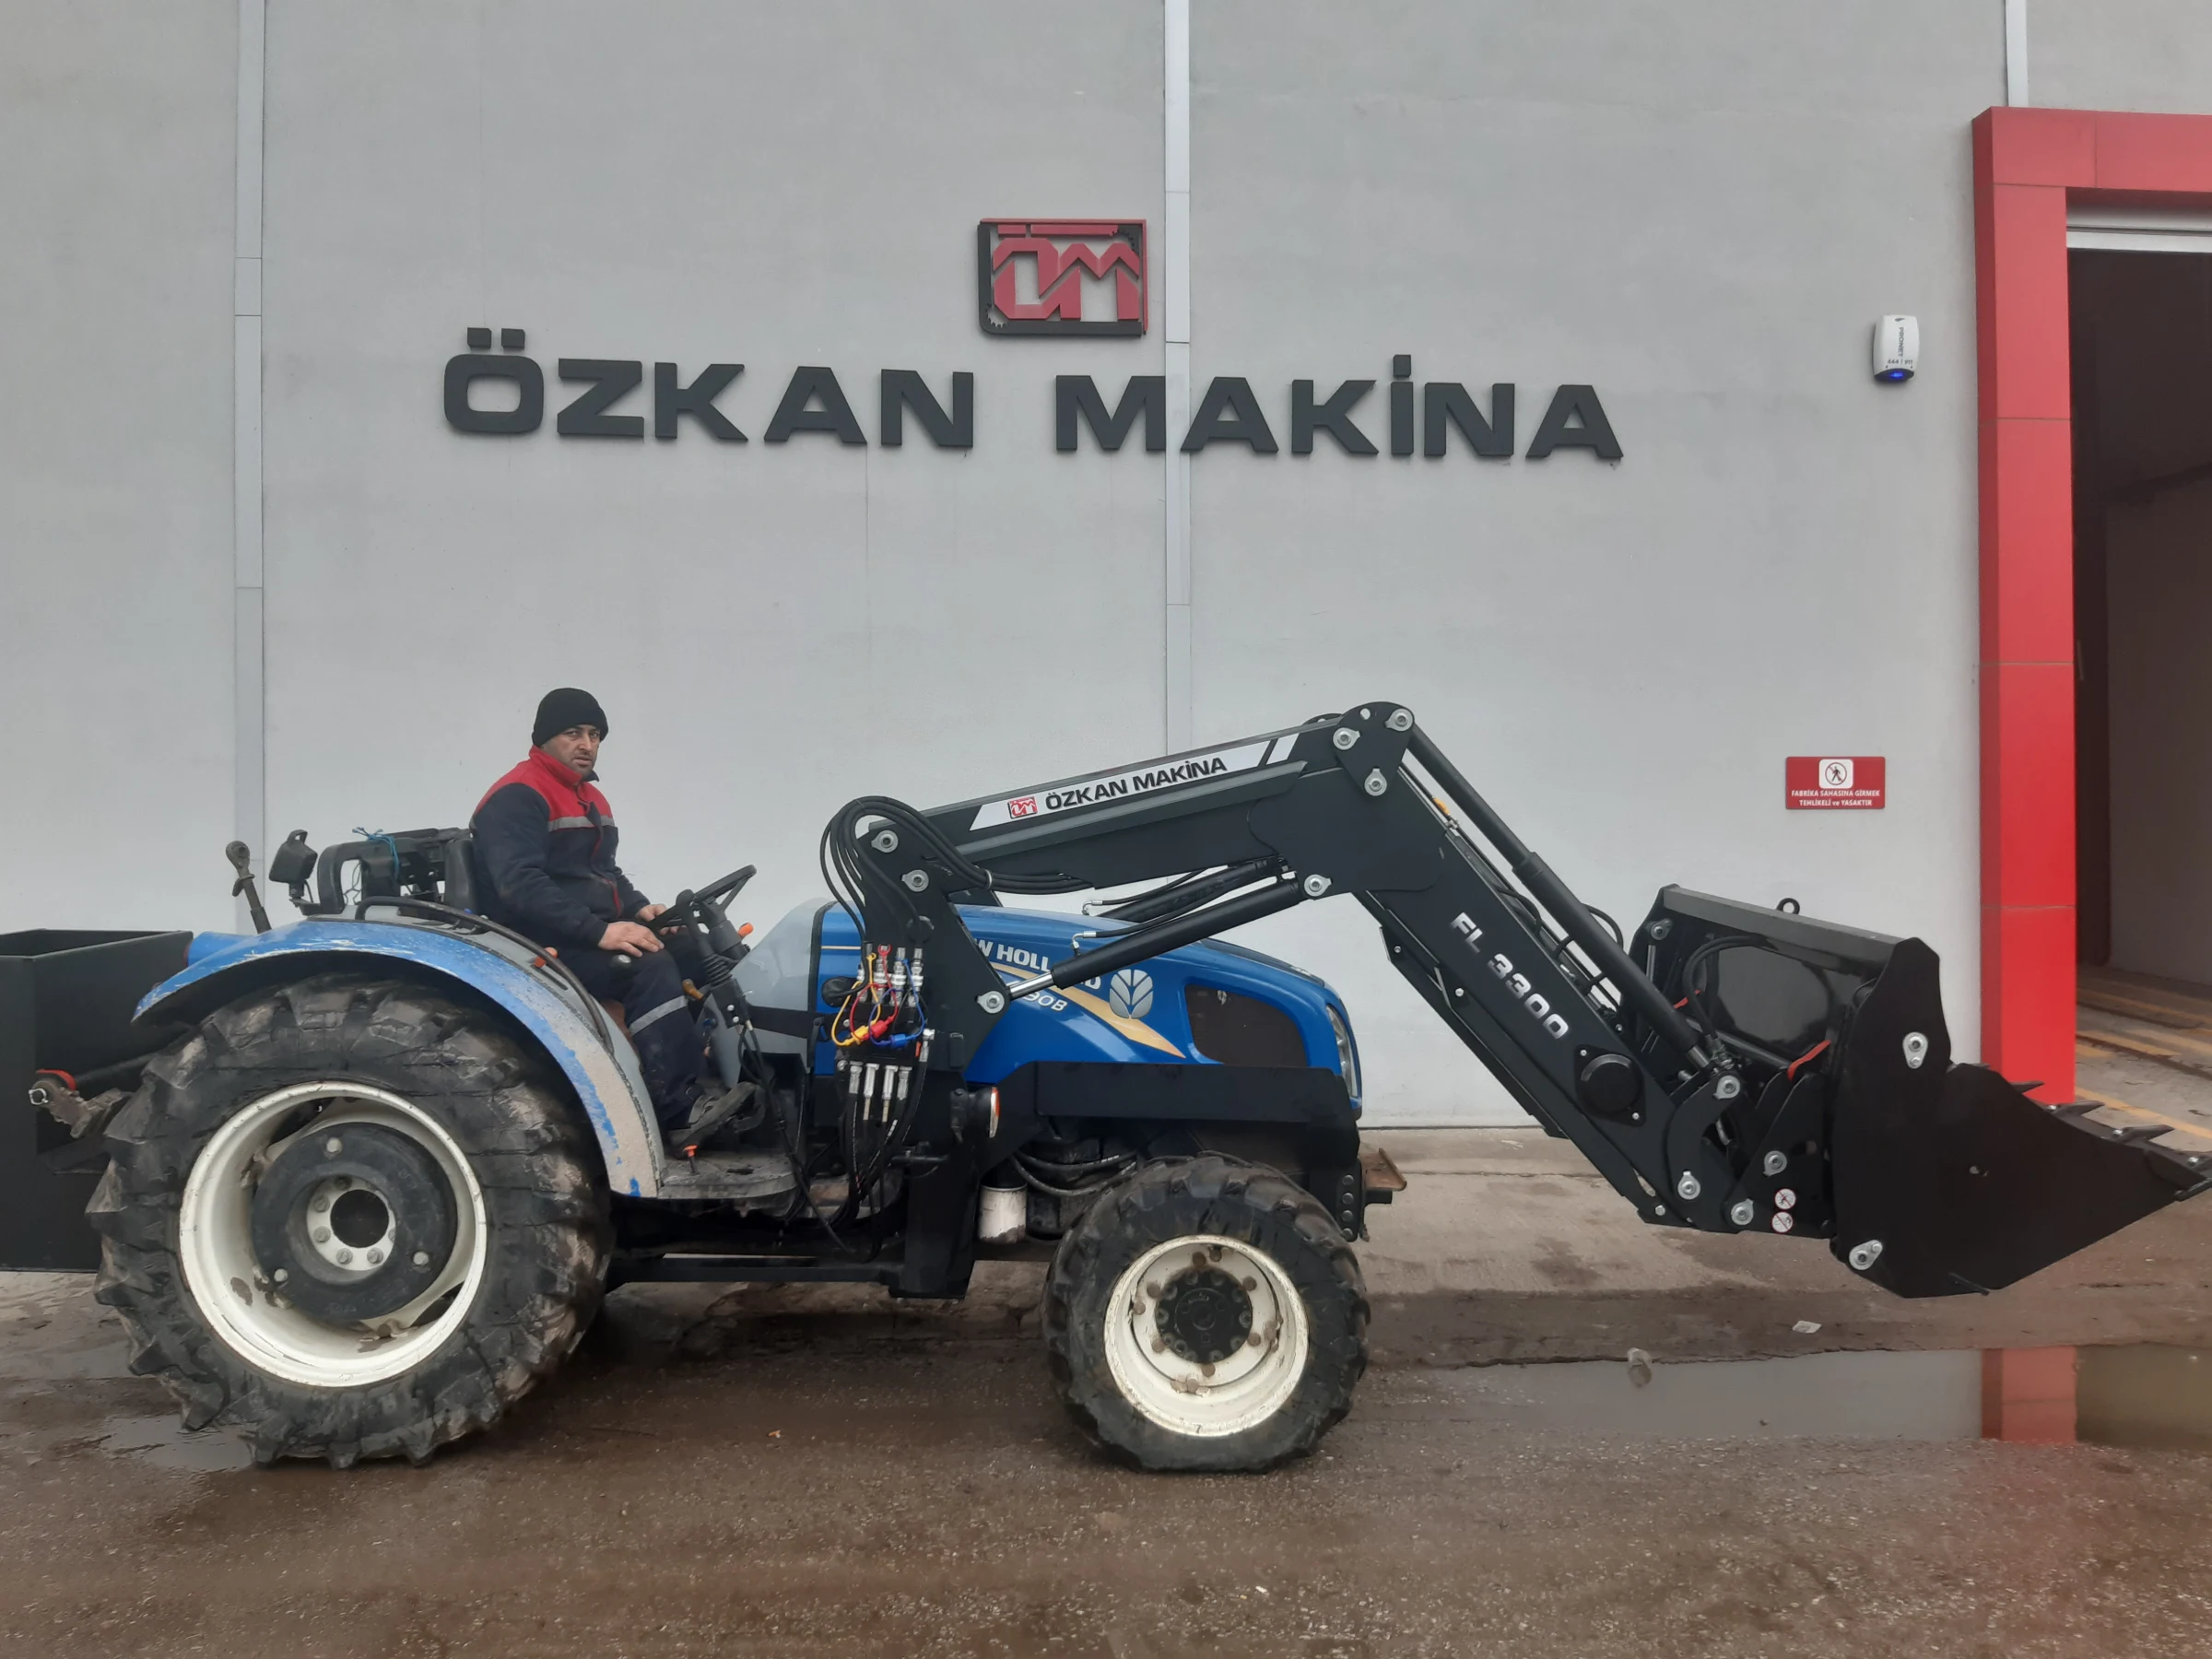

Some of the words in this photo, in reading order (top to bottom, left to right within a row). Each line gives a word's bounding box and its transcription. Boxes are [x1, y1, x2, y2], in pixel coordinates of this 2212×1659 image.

[443, 327, 974, 448] ÖZKAN
[1055, 354, 1624, 459] MAKİNA
[1045, 780, 1127, 810] ÖZKAN
[1133, 757, 1227, 791] MAKİNA
[1799, 798, 1831, 806] TEHLİKELİ
[1854, 789, 1880, 797] GİRMEK
[1450, 912, 1483, 954] FL
[1487, 953, 1569, 1040] 3300
